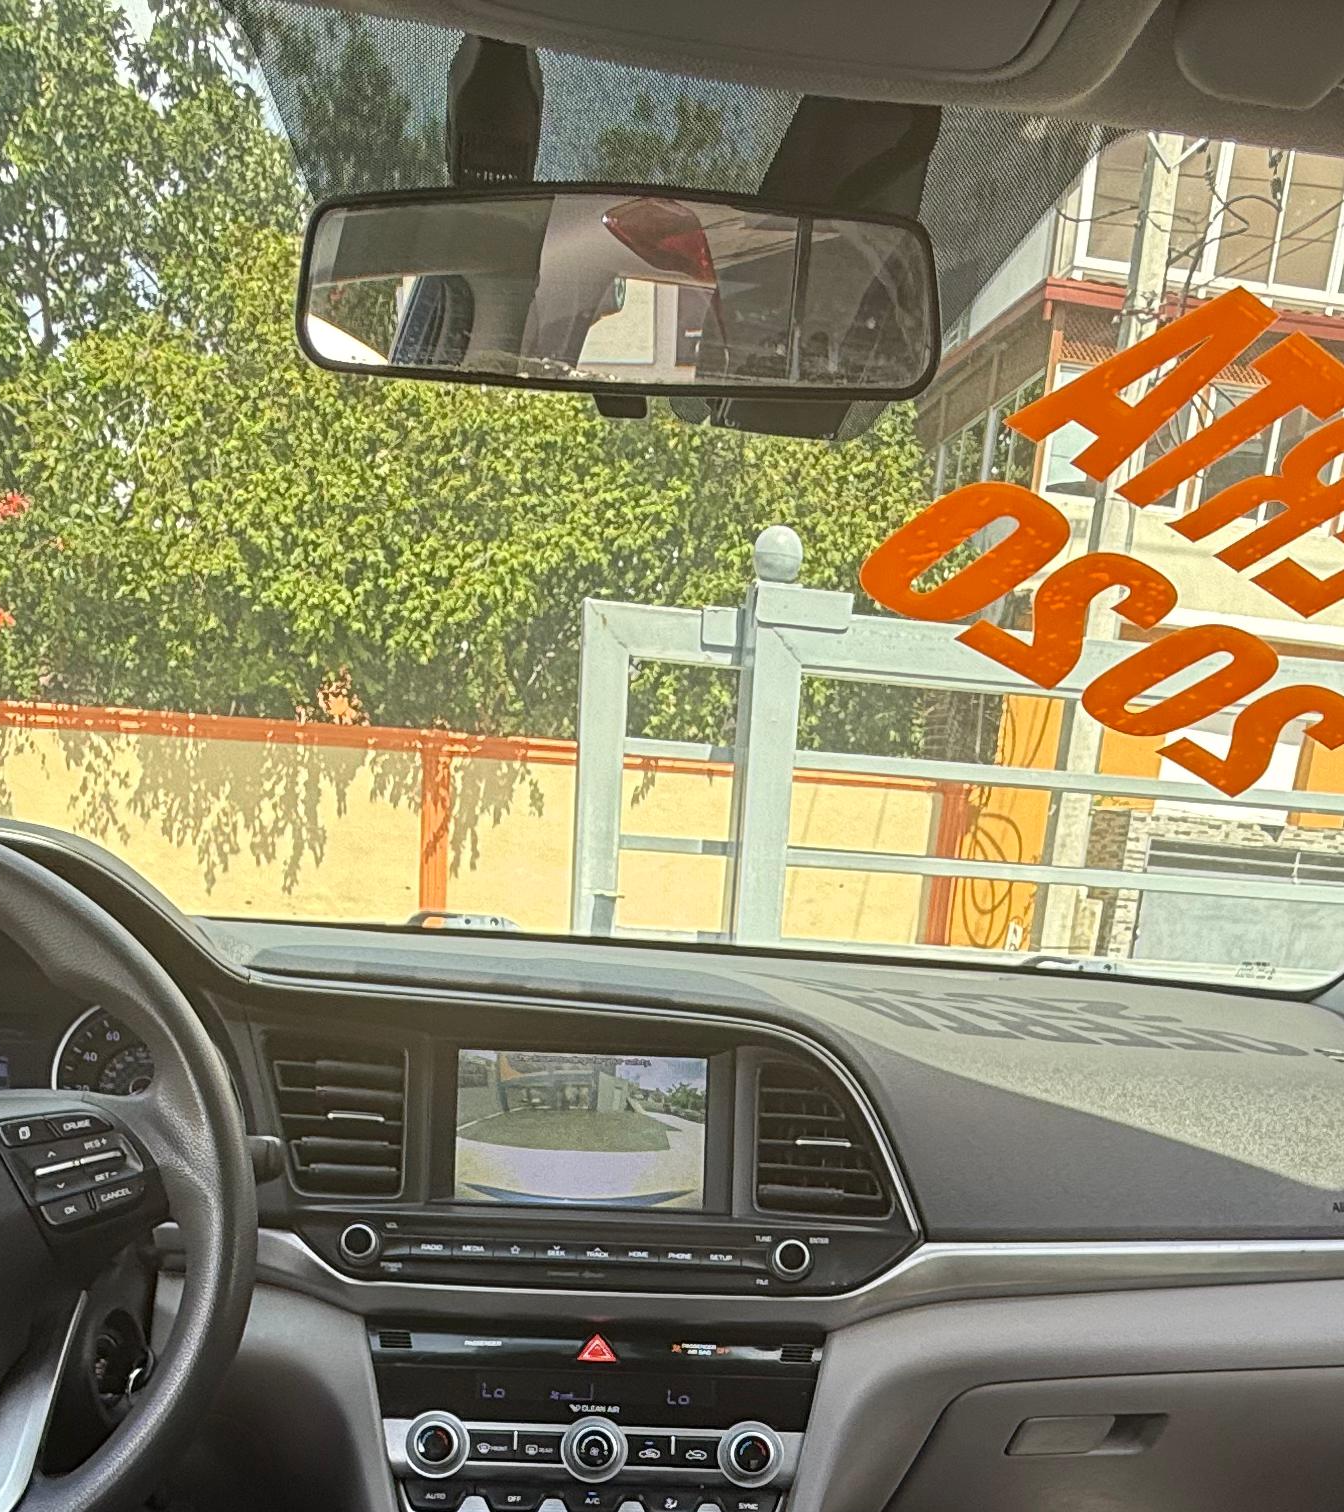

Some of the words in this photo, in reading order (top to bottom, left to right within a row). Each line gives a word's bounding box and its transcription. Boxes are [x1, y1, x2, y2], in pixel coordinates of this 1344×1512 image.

[106, 1031, 120, 1041] 60
[83, 1052, 97, 1062] 40
[62, 1119, 92, 1131] CRUISE
[100, 1188, 132, 1202] CANCEL
[64, 1205, 78, 1215] OK
[462, 1244, 485, 1253] MEDIA
[628, 1251, 649, 1259] HOME
[668, 1253, 692, 1261] PHONE
[709, 1254, 733, 1262] SETUP
[581, 1405, 606, 1413] CLEAN
[607, 1405, 620, 1414] AIR
[425, 1492, 447, 1500] AUTO
[507, 1495, 521, 1503] OFF
[585, 1497, 601, 1505] A/C
